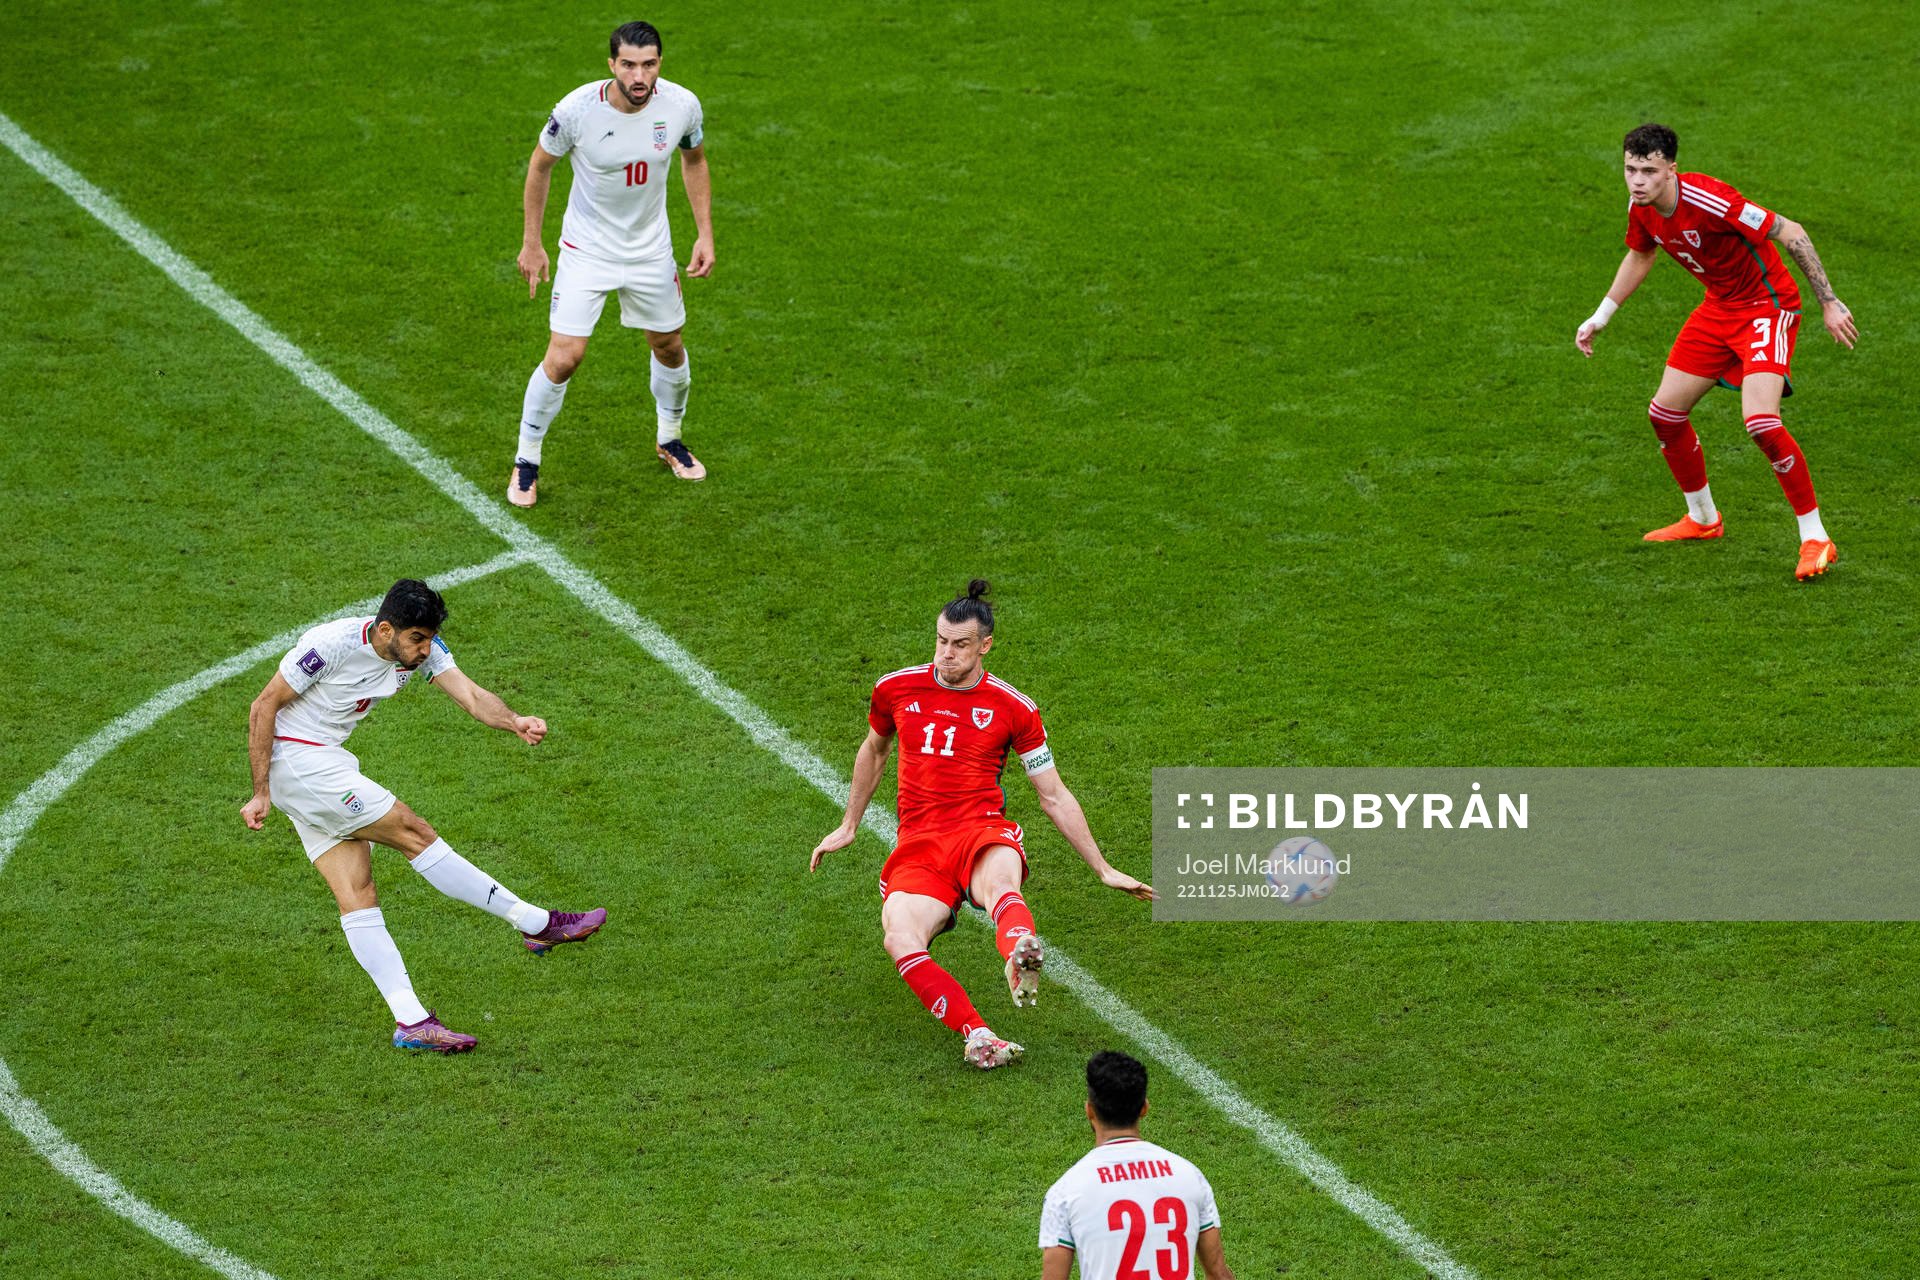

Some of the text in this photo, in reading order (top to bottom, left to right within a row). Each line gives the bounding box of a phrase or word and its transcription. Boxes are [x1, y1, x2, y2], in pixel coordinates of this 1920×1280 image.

[623, 160, 648, 187] 10
[1750, 317, 1772, 349] 3
[920, 722, 957, 757] 11
[1026, 754, 1043, 765] SAVE
[1097, 1160, 1174, 1184] RAMIN
[1107, 1196, 1190, 1280] 23
